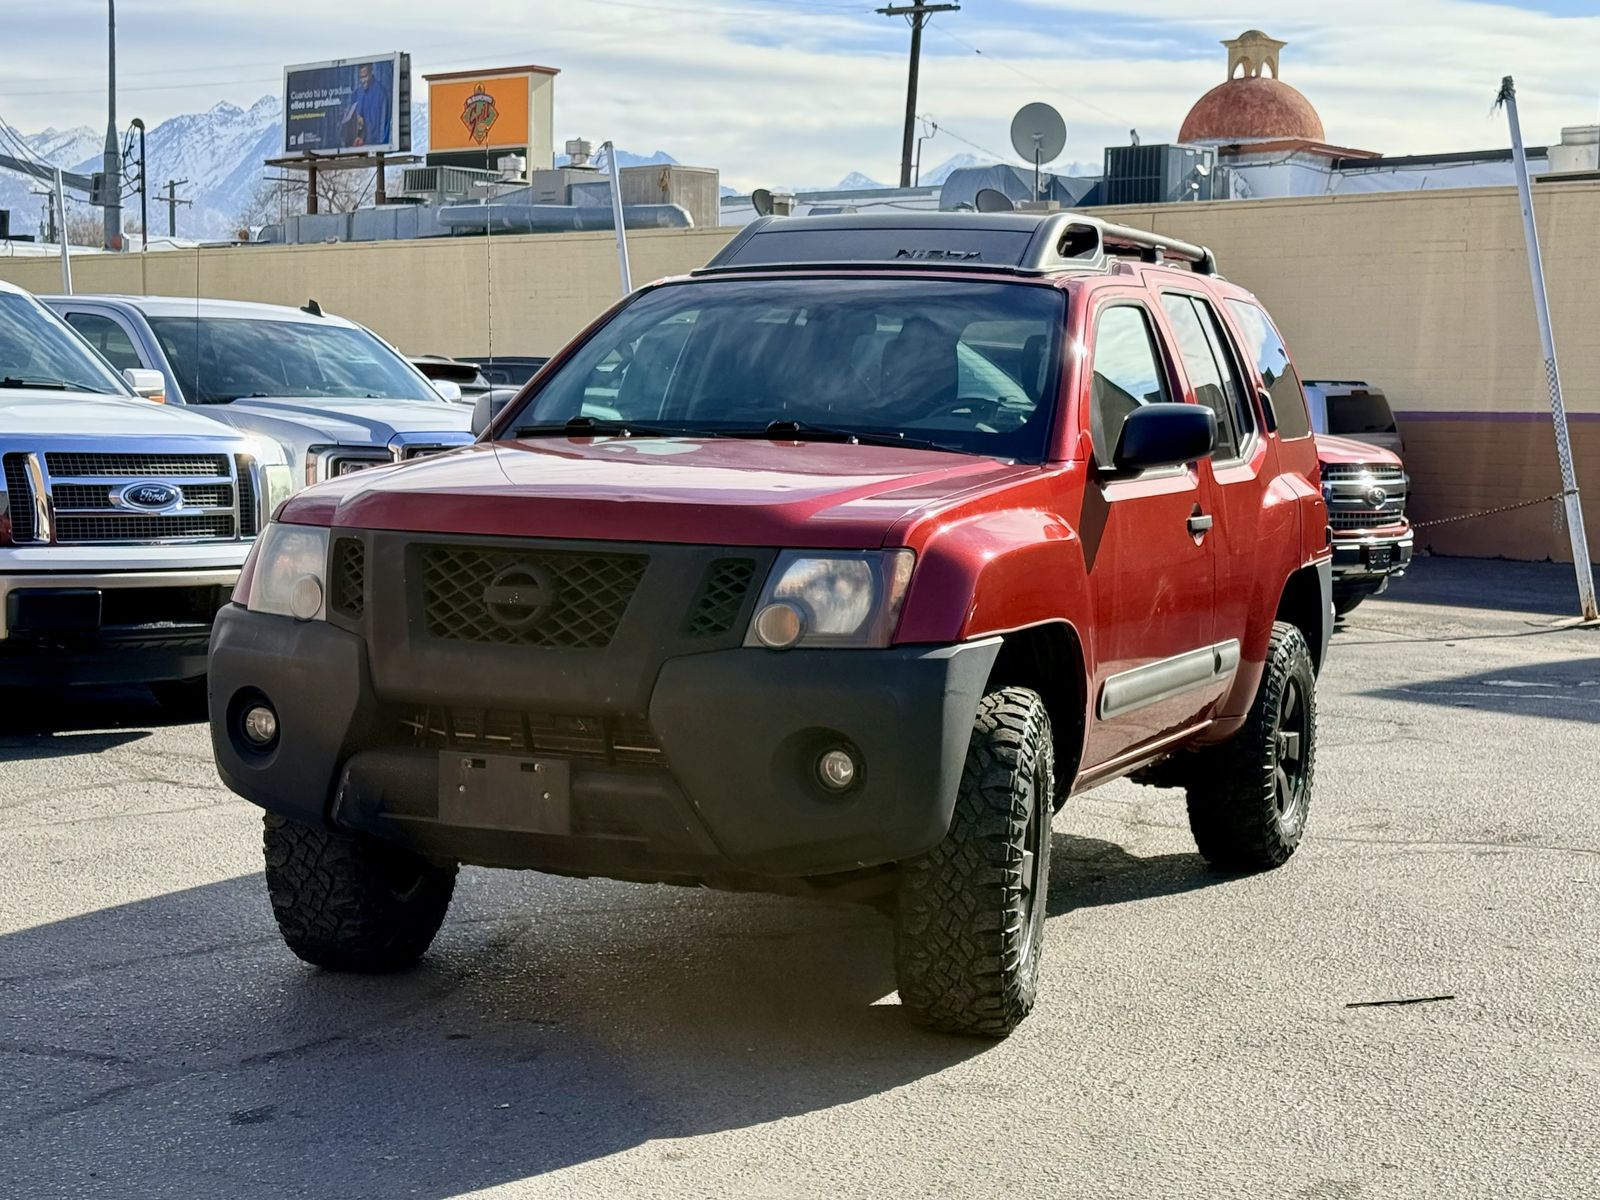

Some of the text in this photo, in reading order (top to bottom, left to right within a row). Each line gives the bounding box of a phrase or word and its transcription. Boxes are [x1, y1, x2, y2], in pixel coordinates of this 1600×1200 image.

[290, 90, 313, 100] Cuando
[290, 100, 305, 110] ellos
[307, 101, 313, 109] se
[139, 488, 167, 502] Ford
